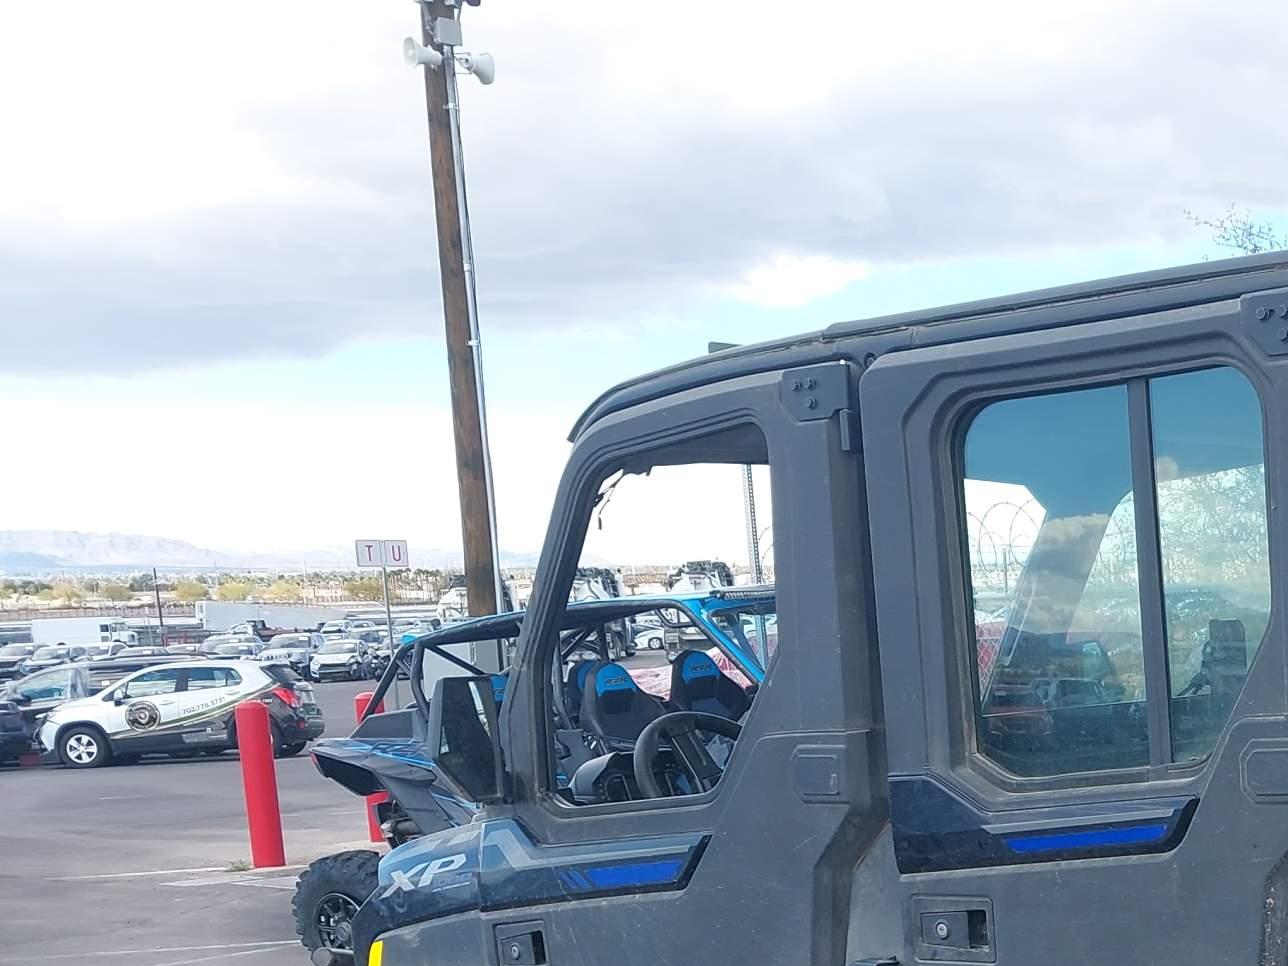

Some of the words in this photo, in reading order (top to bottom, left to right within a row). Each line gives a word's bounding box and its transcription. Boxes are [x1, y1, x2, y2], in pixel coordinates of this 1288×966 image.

[364, 545, 373, 561] T
[392, 545, 401, 561] U
[380, 853, 467, 899] XP
